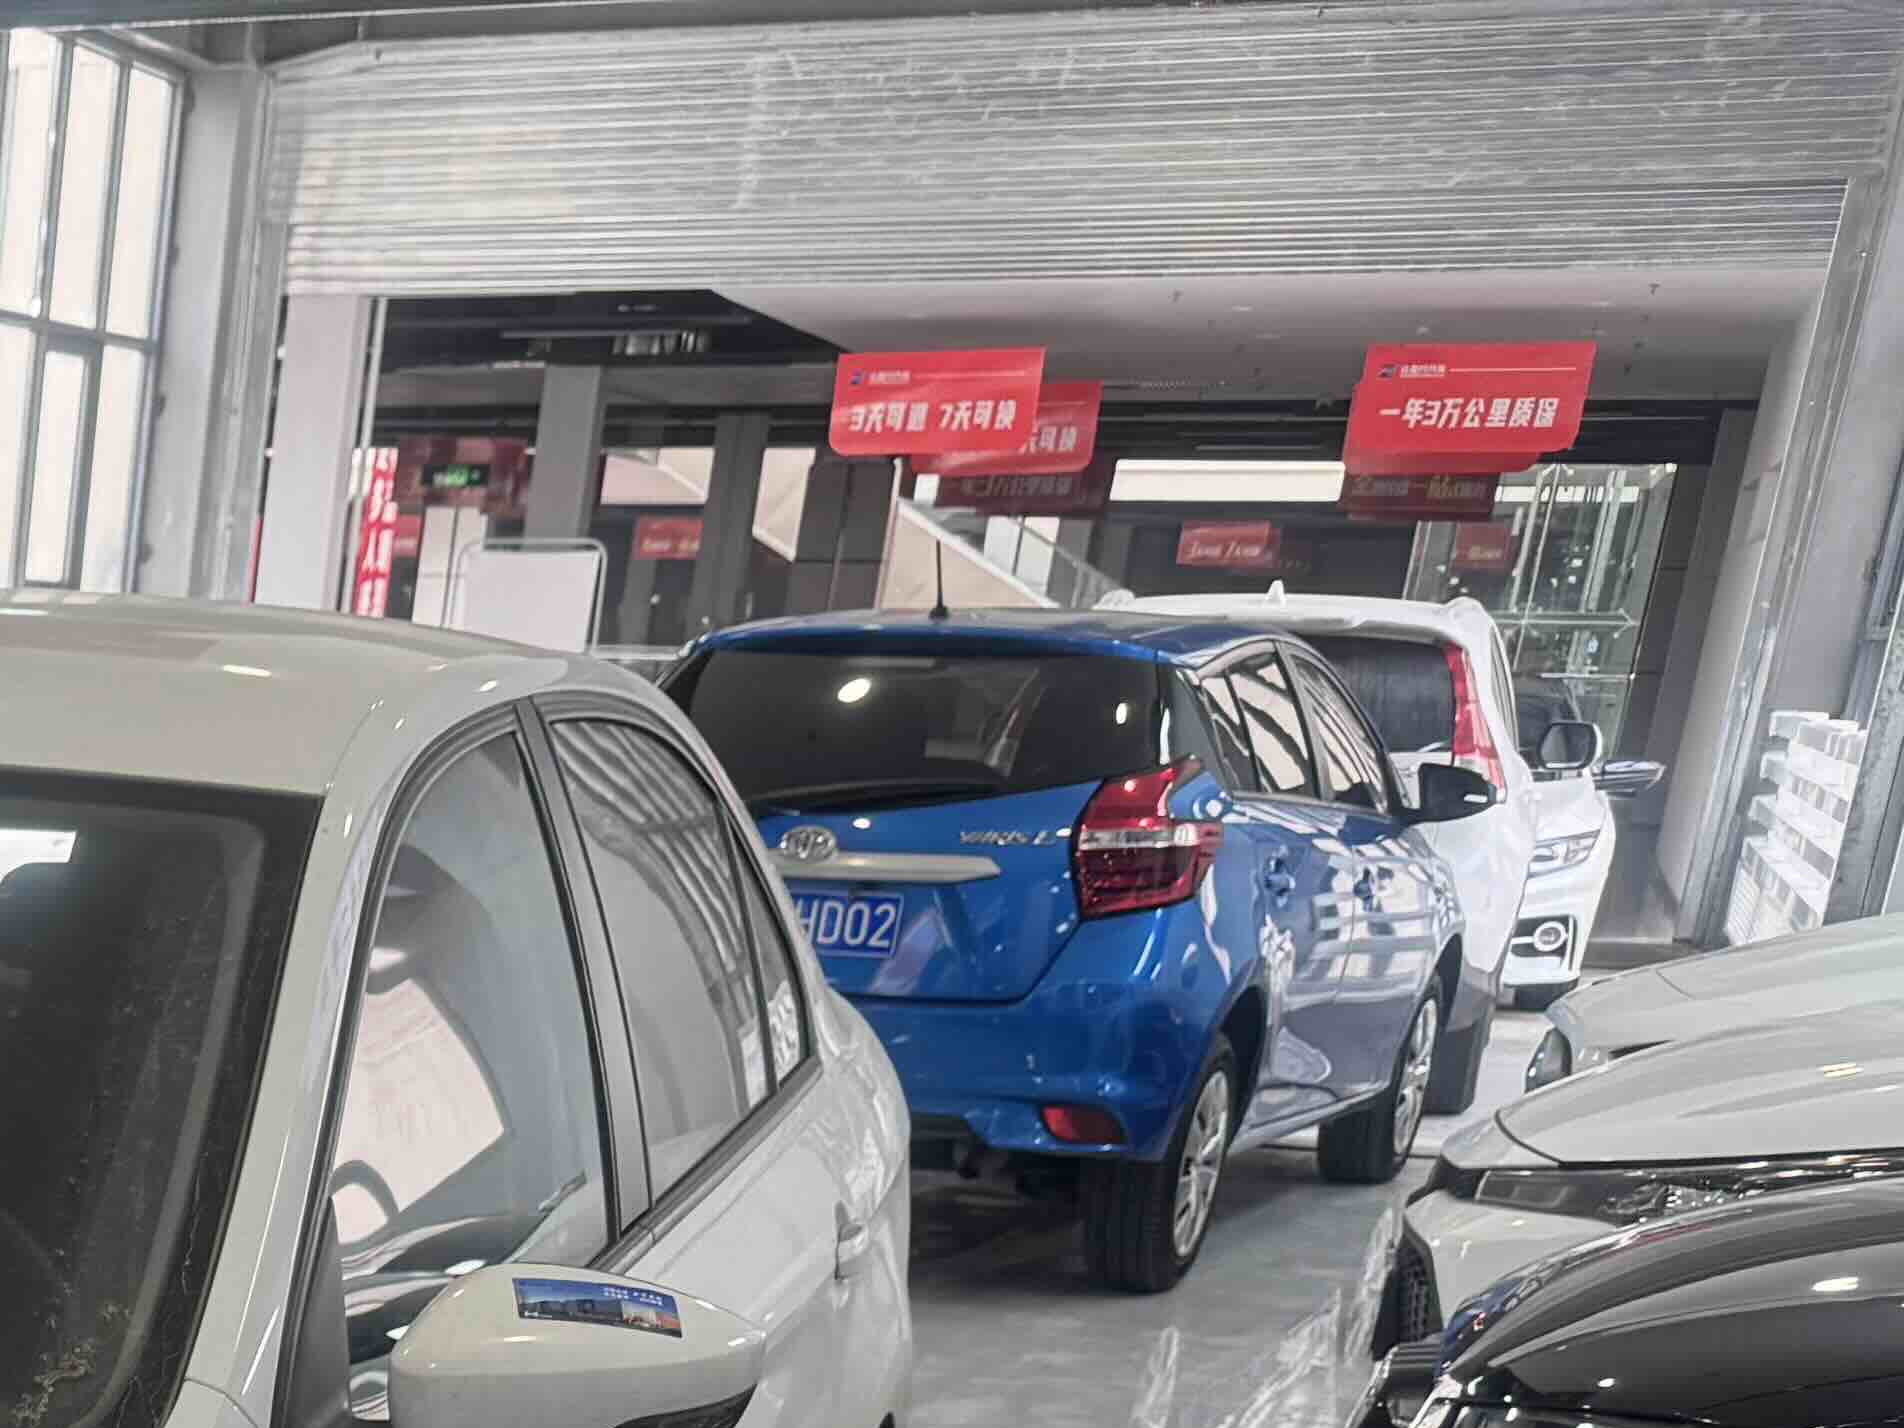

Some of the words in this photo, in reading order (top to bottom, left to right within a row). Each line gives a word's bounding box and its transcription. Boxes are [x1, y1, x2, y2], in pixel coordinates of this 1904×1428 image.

[1379, 397, 1561, 429] 一年3万公里质保
